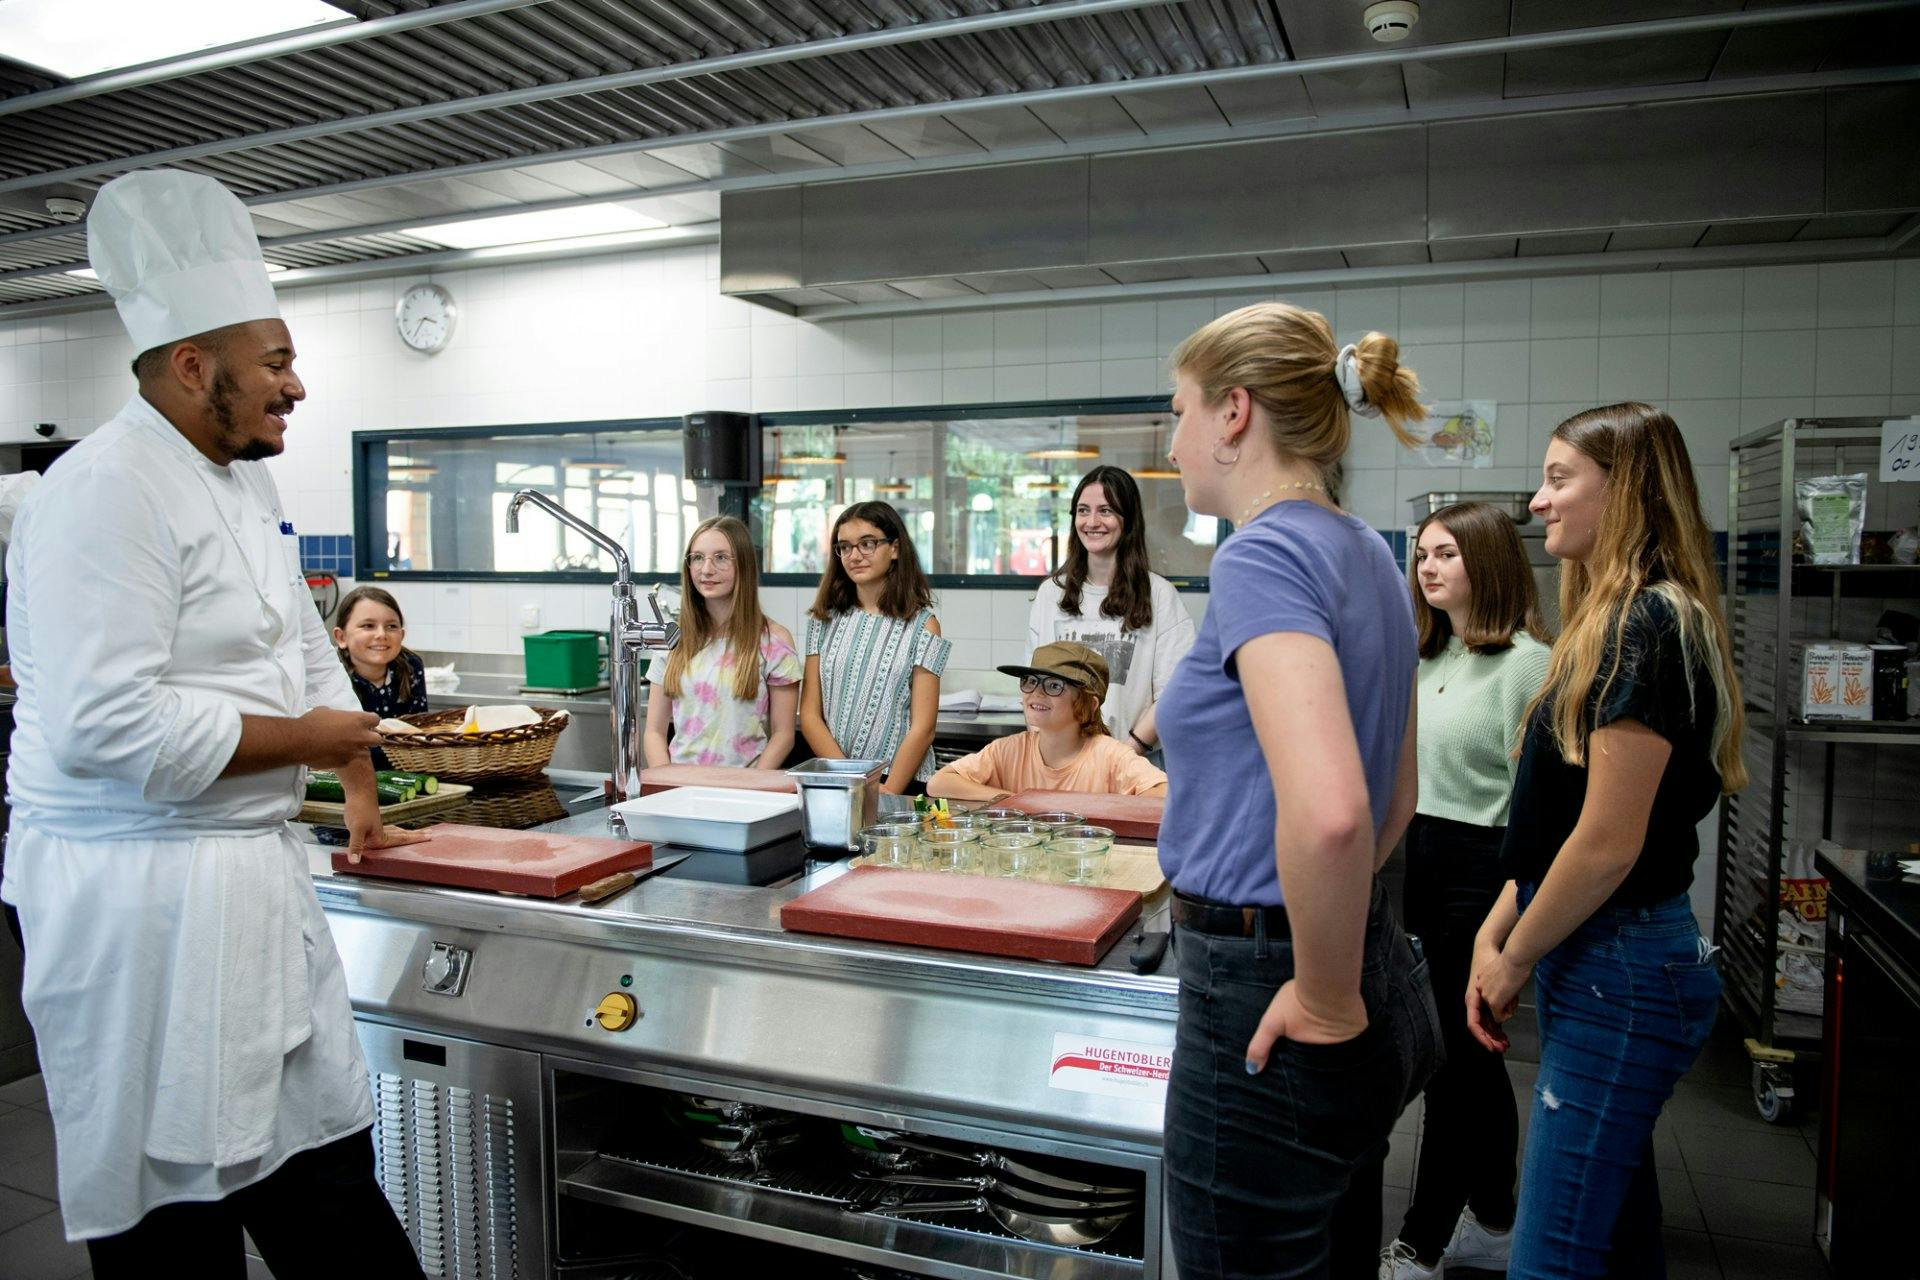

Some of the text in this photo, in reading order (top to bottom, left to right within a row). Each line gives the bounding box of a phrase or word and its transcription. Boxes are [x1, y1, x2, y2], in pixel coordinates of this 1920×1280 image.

[1888, 434, 1920, 453] 19
[1085, 1046, 1171, 1067] HUGENTOBLER
[1099, 1062, 1112, 1072] Der
